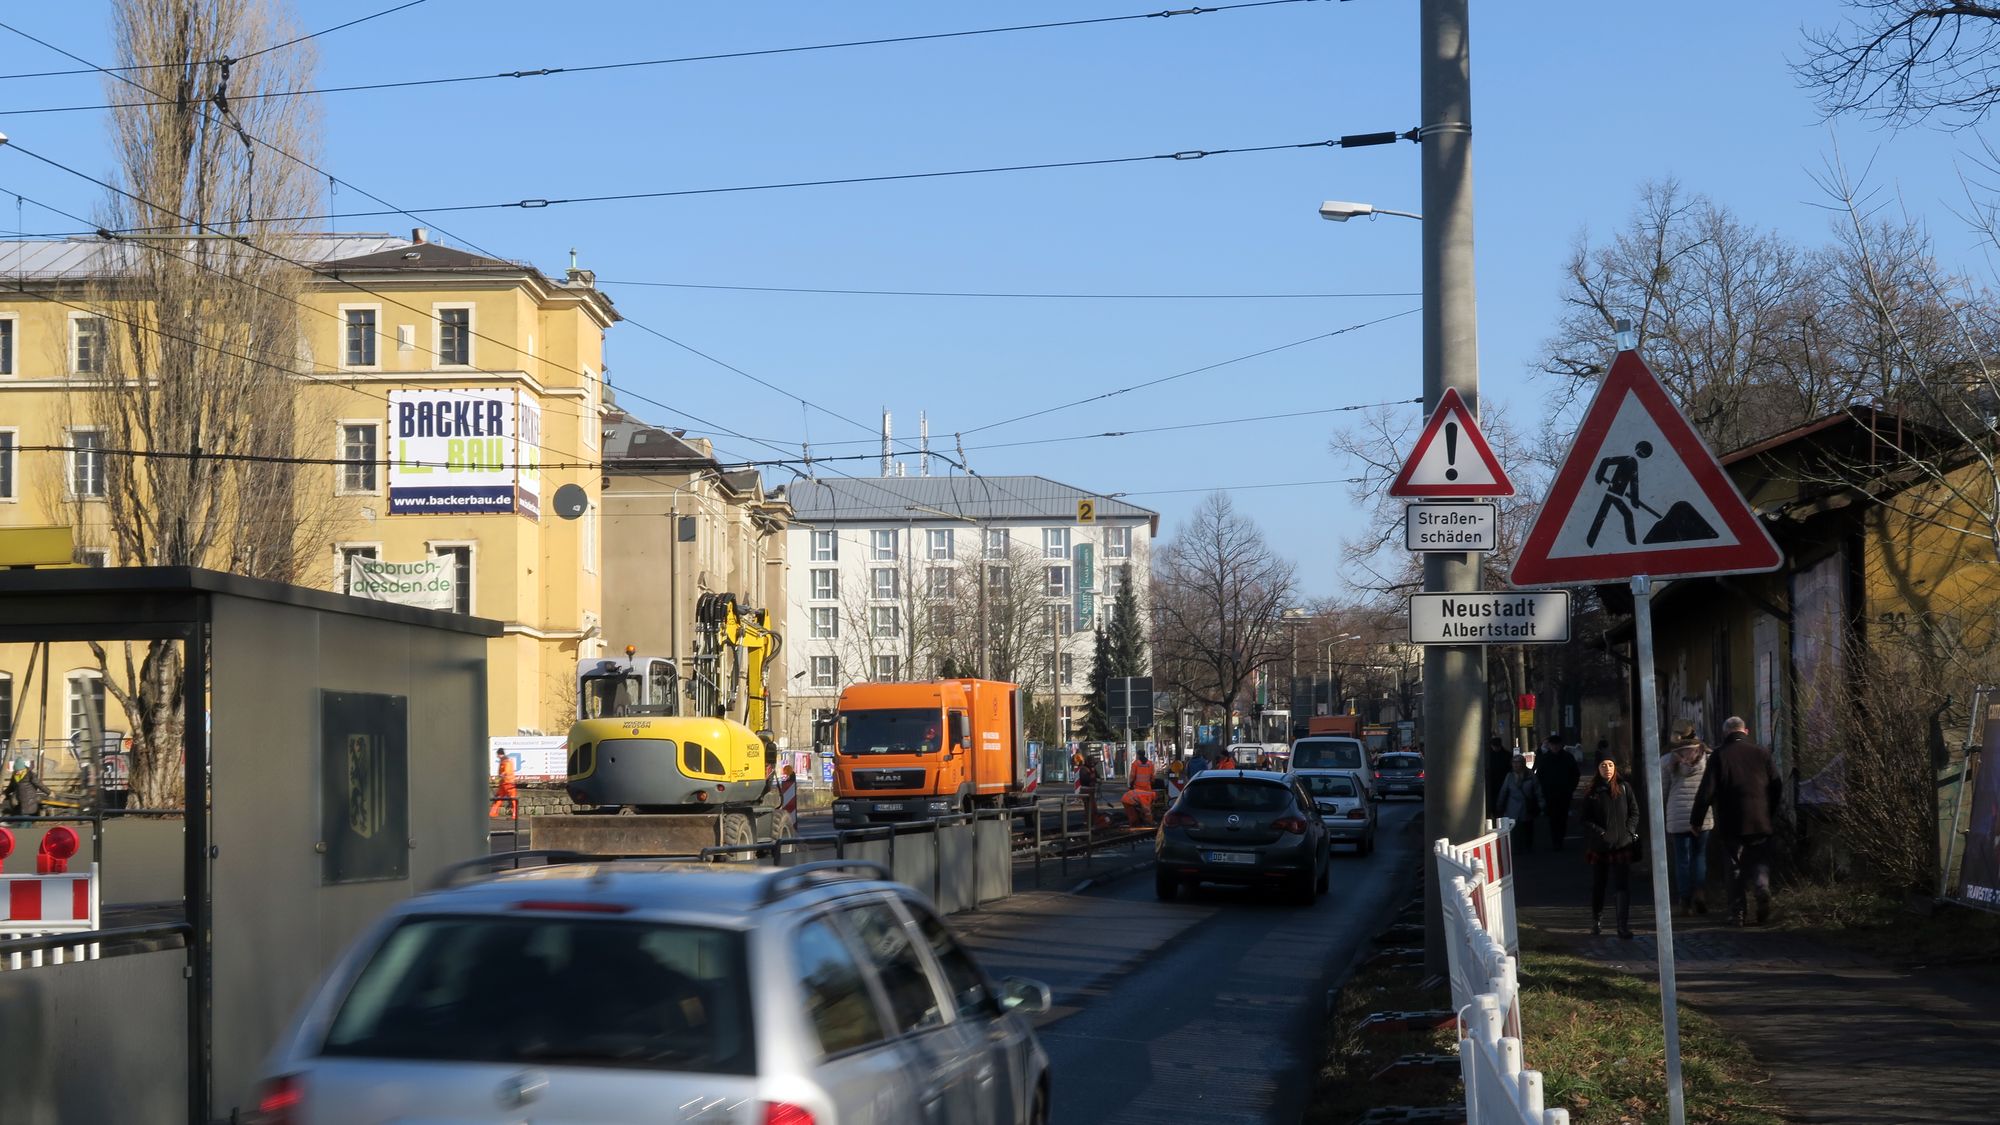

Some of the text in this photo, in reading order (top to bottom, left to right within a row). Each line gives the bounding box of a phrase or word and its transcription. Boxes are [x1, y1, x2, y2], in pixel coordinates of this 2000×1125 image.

[399, 400, 503, 437] BACKER
[447, 438, 503, 473] BAU
[394, 495, 511, 506] www.backerbau.de
[1080, 503, 1092, 521] 2
[1418, 512, 1485, 525] Straßen-
[1420, 530, 1482, 543] schäden
[363, 560, 441, 575] abbruch-
[353, 577, 450, 593] dresden.de
[1442, 598, 1536, 618] Neustadt
[1442, 622, 1537, 637] Albertstadt
